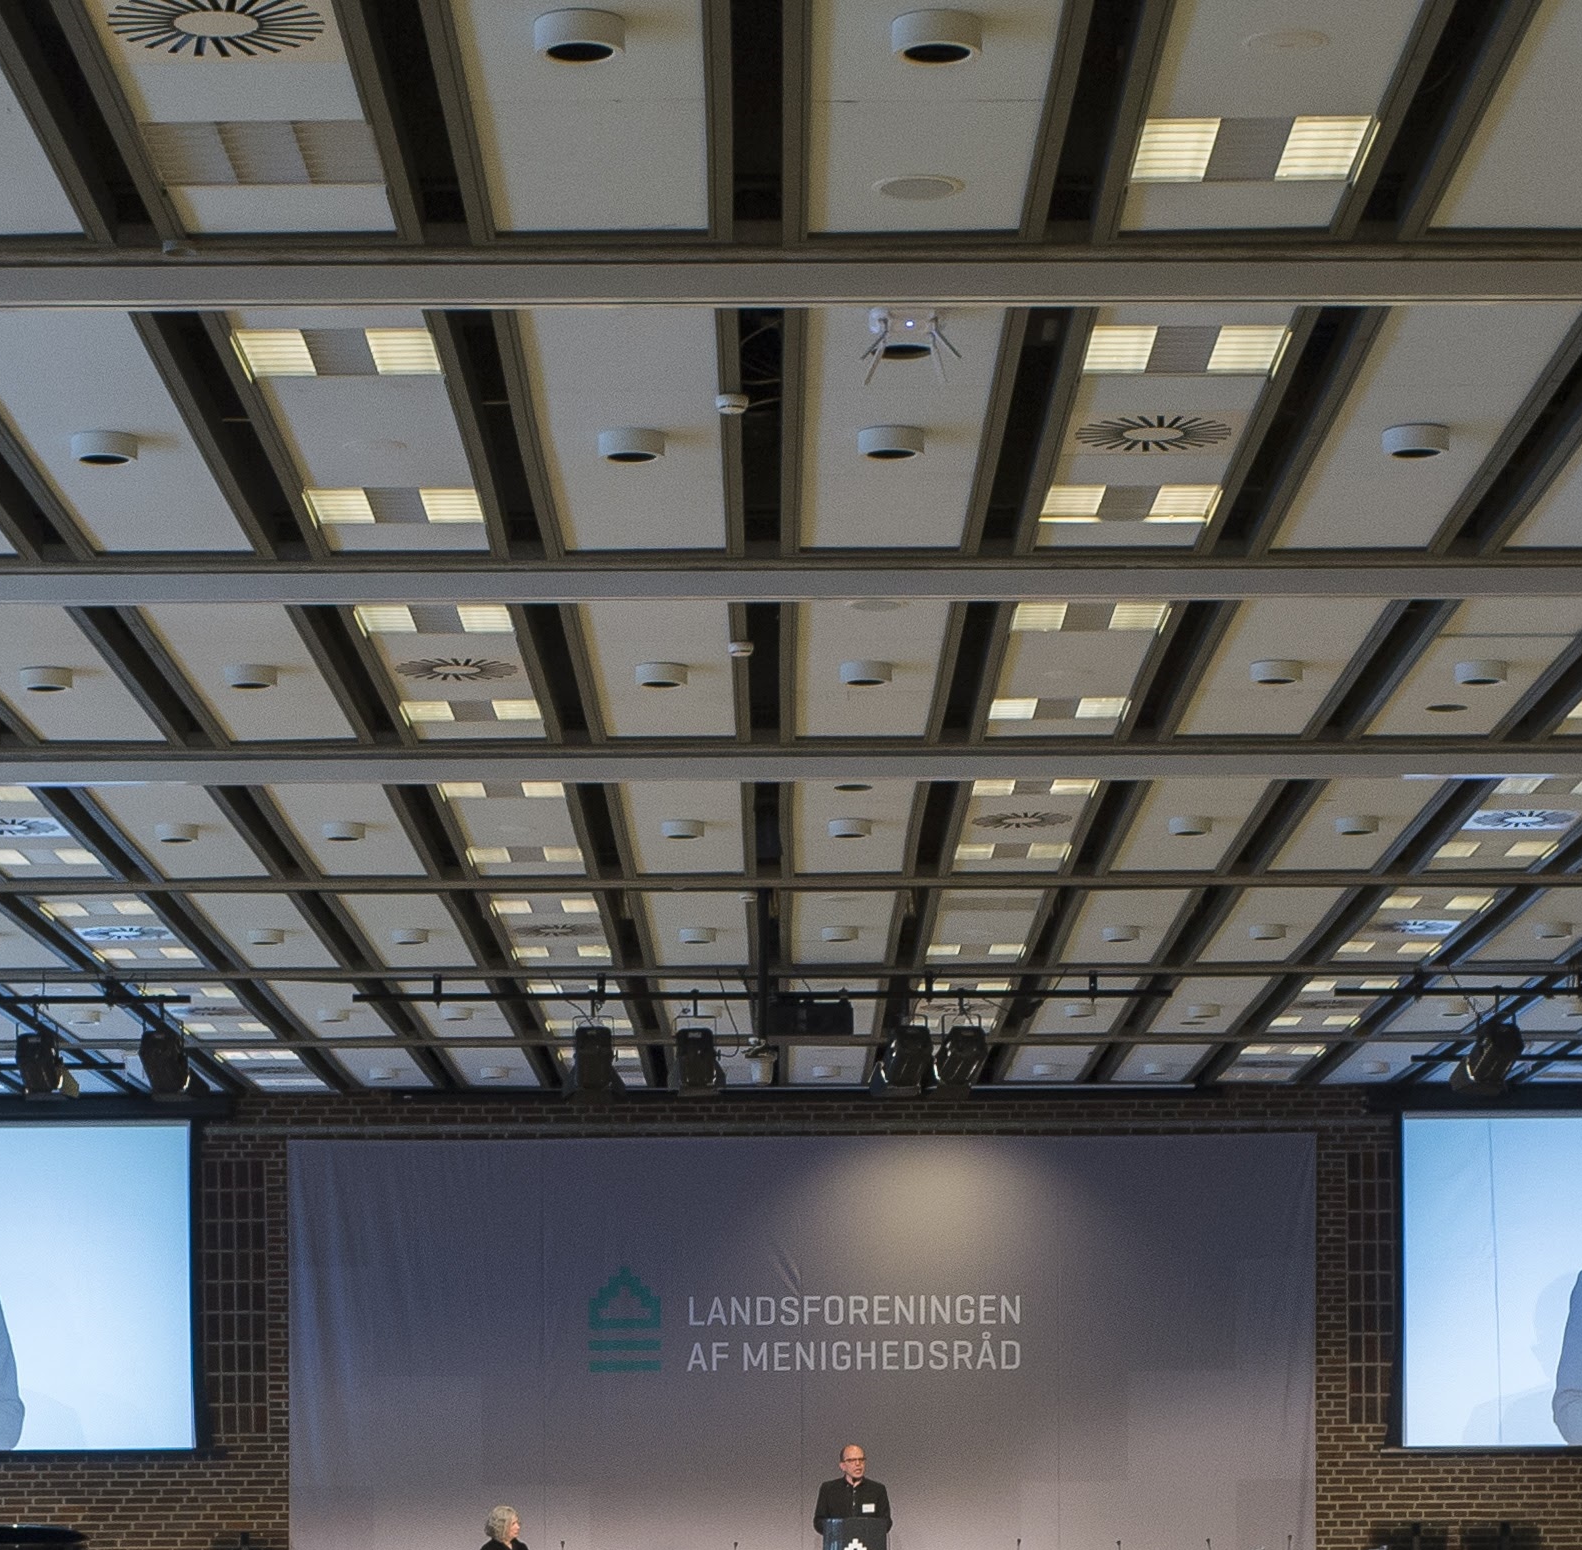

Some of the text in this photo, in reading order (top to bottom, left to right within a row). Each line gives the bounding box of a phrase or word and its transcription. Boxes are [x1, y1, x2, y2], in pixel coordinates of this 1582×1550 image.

[687, 1294, 1022, 1327] LANDSFORENINGEN
[686, 1331, 1022, 1372] AF MENIGHEDSRÅD
